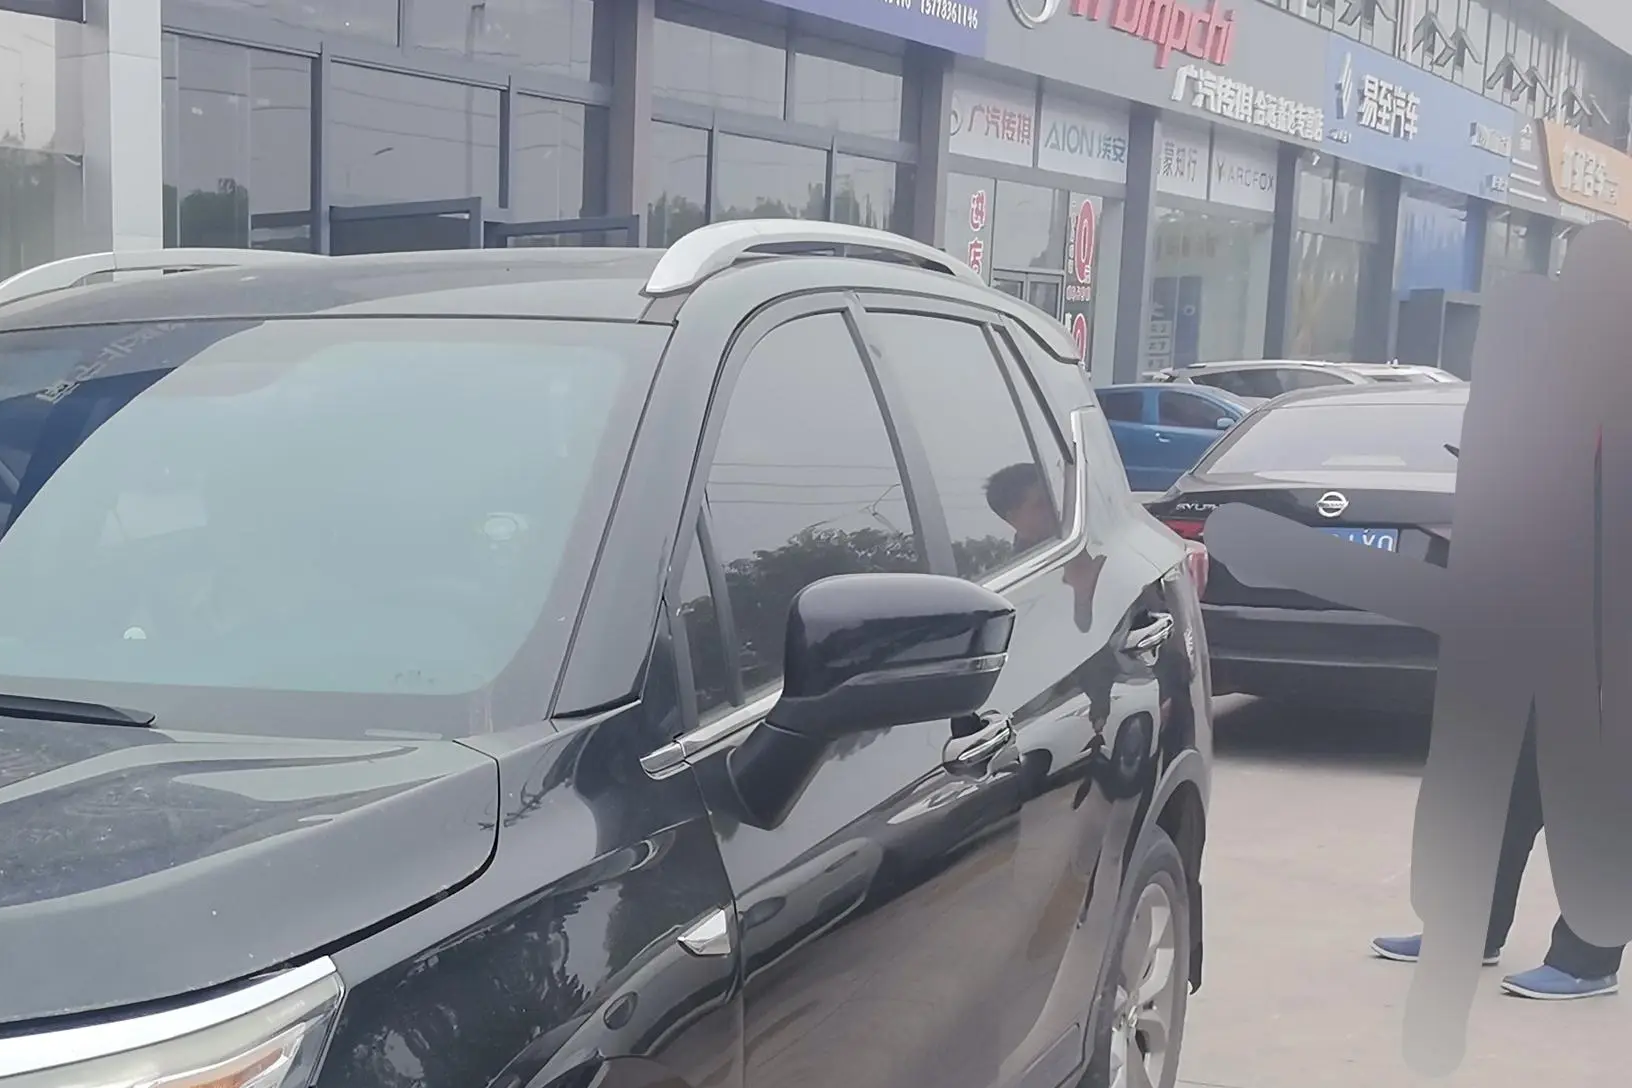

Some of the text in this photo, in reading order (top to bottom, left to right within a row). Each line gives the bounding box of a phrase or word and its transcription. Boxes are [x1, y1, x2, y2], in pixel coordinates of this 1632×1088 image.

[1069, 0, 1236, 69] umpchi
[1171, 64, 1254, 124] 广汽传祺
[1359, 74, 1421, 141] 易至汽车
[968, 104, 1032, 146] 广汽传祺
[1044, 120, 1094, 157] AION
[1227, 165, 1274, 192] ARCFOX
